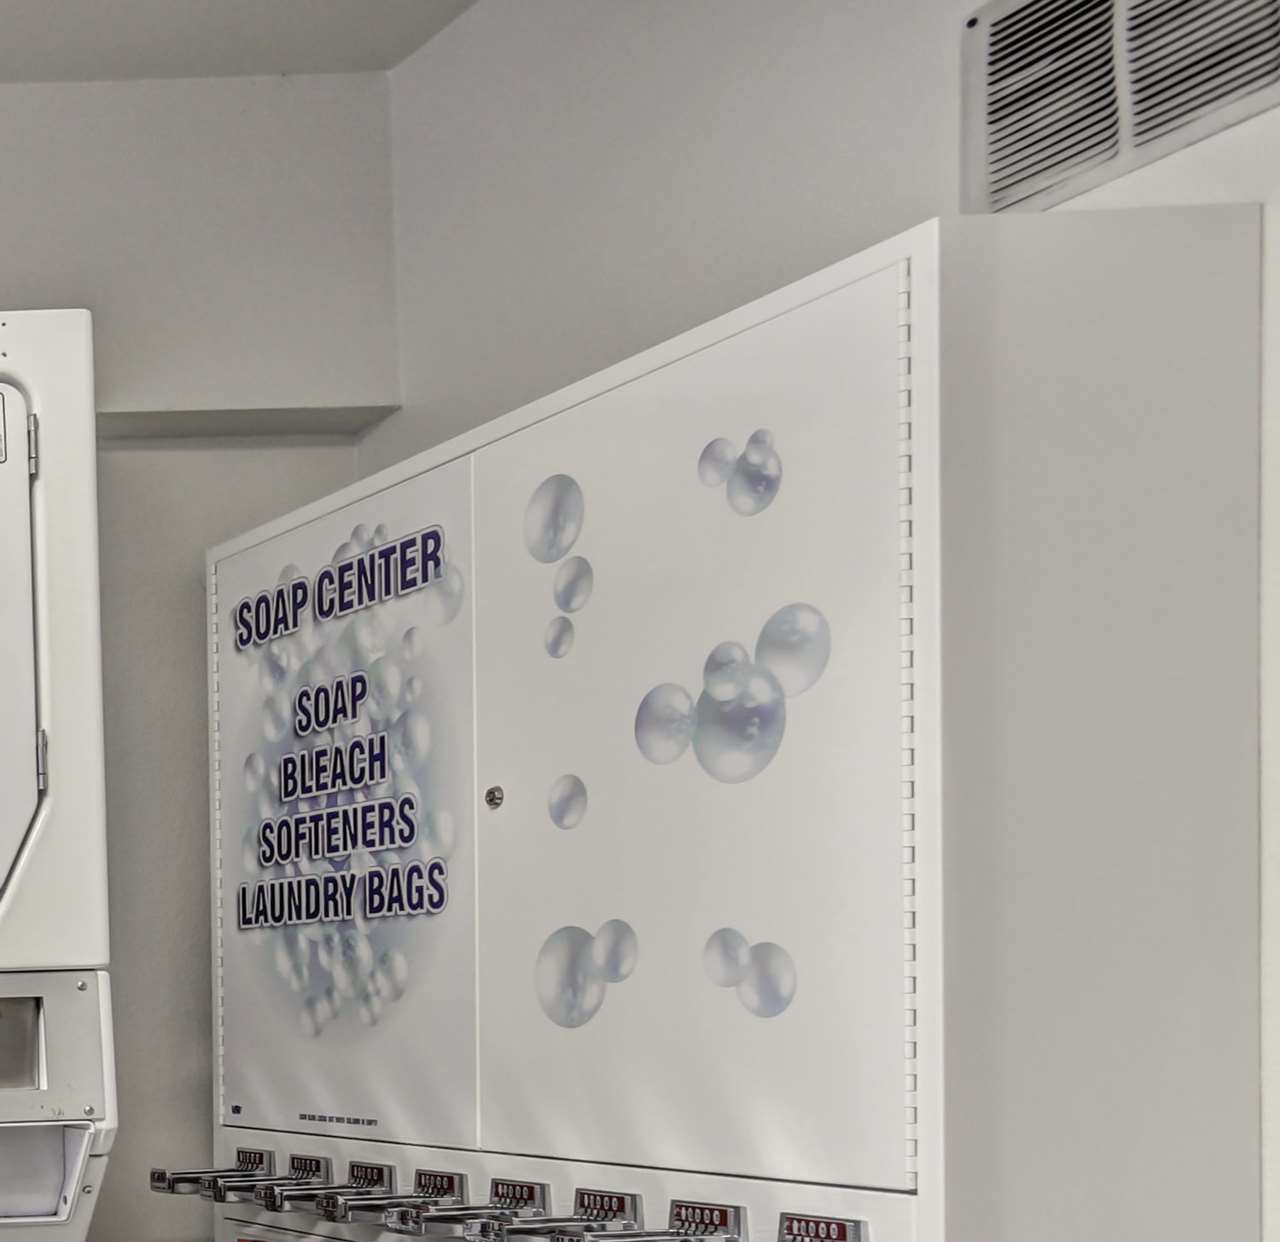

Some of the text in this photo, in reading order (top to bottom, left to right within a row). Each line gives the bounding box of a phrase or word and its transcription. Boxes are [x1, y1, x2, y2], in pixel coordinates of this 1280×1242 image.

[237, 528, 445, 646] SOAP CENTER
[297, 673, 368, 735] SOAP
[282, 734, 388, 800] BLEACH
[260, 793, 417, 866] SOFTENERS
[240, 858, 448, 929] LAUNDRY BAGS
